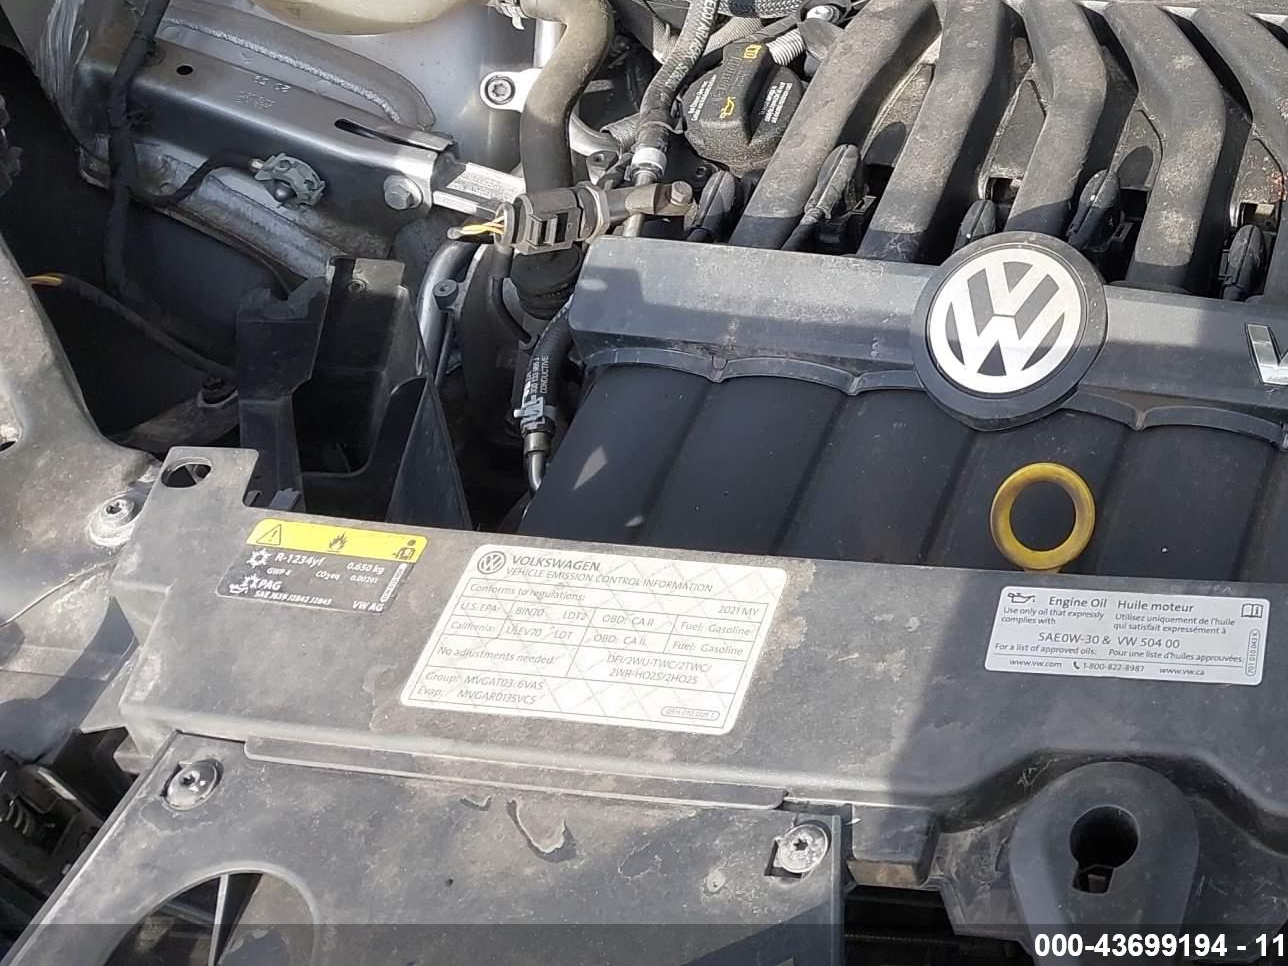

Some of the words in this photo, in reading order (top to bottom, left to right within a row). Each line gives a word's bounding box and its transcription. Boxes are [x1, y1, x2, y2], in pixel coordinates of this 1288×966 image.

[273, 552, 327, 569] R-1234yf
[512, 554, 602, 572] VOLKSWAGEN
[346, 561, 374, 573] 0.650
[371, 564, 386, 576] kg
[257, 578, 283, 592] PAG
[506, 567, 546, 579] VEHICLE
[545, 570, 595, 583] EMISSION
[595, 573, 641, 587] CONTROL
[642, 578, 714, 594] INFORMATION
[469, 583, 517, 596] Conforms
[517, 587, 530, 597] to
[352, 600, 371, 610] VW
[367, 602, 385, 613] AG
[1048, 595, 1089, 609] Engine
[1090, 598, 1108, 609] Oil
[1117, 599, 1149, 611] Huile
[1150, 602, 1195, 613] moteur
[1000, 616, 1037, 626] complies
[1037, 617, 1057, 626] with
[1003, 607, 1020, 615] Use
[1019, 607, 1038, 617] only
[1037, 608, 1049, 616] oil
[1049, 608, 1067, 618] that
[1067, 610, 1105, 621] expressly
[1114, 613, 1146, 623] Utilisez
[1146, 616, 1198, 625] uniquement
[1197, 617, 1210, 626] de
[1210, 617, 1237, 627] l'huile
[680, 620, 705, 632] Fuel:
[707, 623, 752, 637] Gasoline
[1113, 622, 1128, 631] qui
[1128, 623, 1162, 632] satisfait
[1162, 626, 1221, 635] expressément
[1037, 631, 1101, 645] SAE0W-30
[1101, 635, 1112, 646] &
[1117, 636, 1139, 647] VW
[1140, 637, 1163, 648] 504
[1164, 638, 1181, 650] 00
[671, 640, 697, 652] Fuel:
[699, 643, 745, 657] Gasoline
[1009, 659, 1063, 668] www.vw.com
[1083, 661, 1146, 673] 1-800-822-8987
[1159, 668, 1206, 677] www.vw.ca
